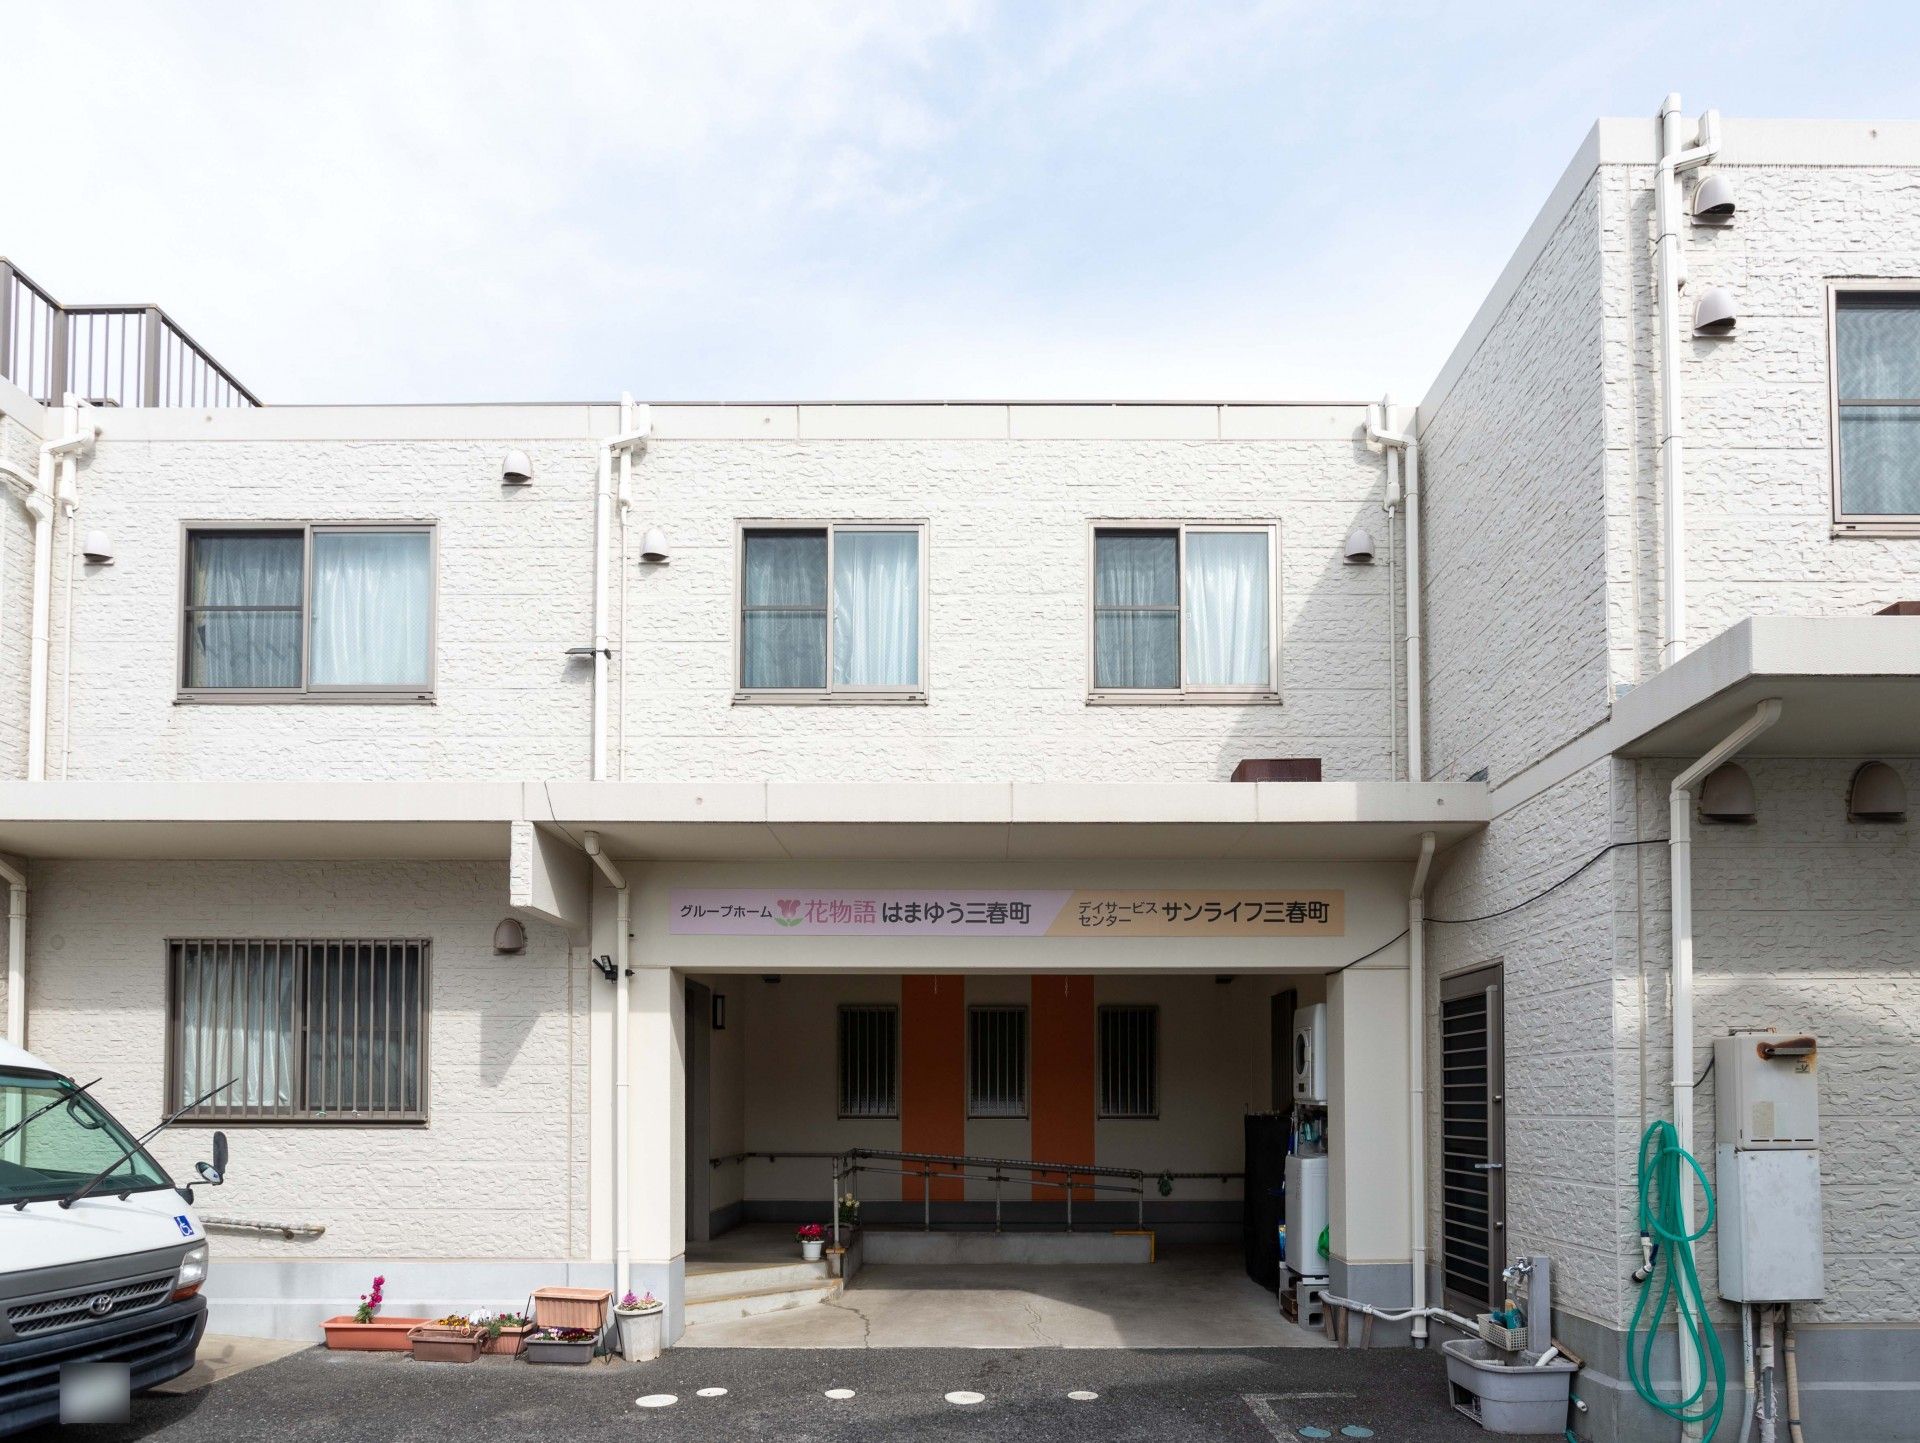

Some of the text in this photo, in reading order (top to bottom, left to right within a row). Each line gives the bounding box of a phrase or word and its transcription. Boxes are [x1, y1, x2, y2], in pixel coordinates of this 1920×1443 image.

[680, 900, 1032, 925] グループホーム 花物語 はまゆう三春町
[1078, 902, 1158, 915] デイサービス
[1162, 901, 1330, 924] サンライフ三春町
[1078, 915, 1132, 927] センター
